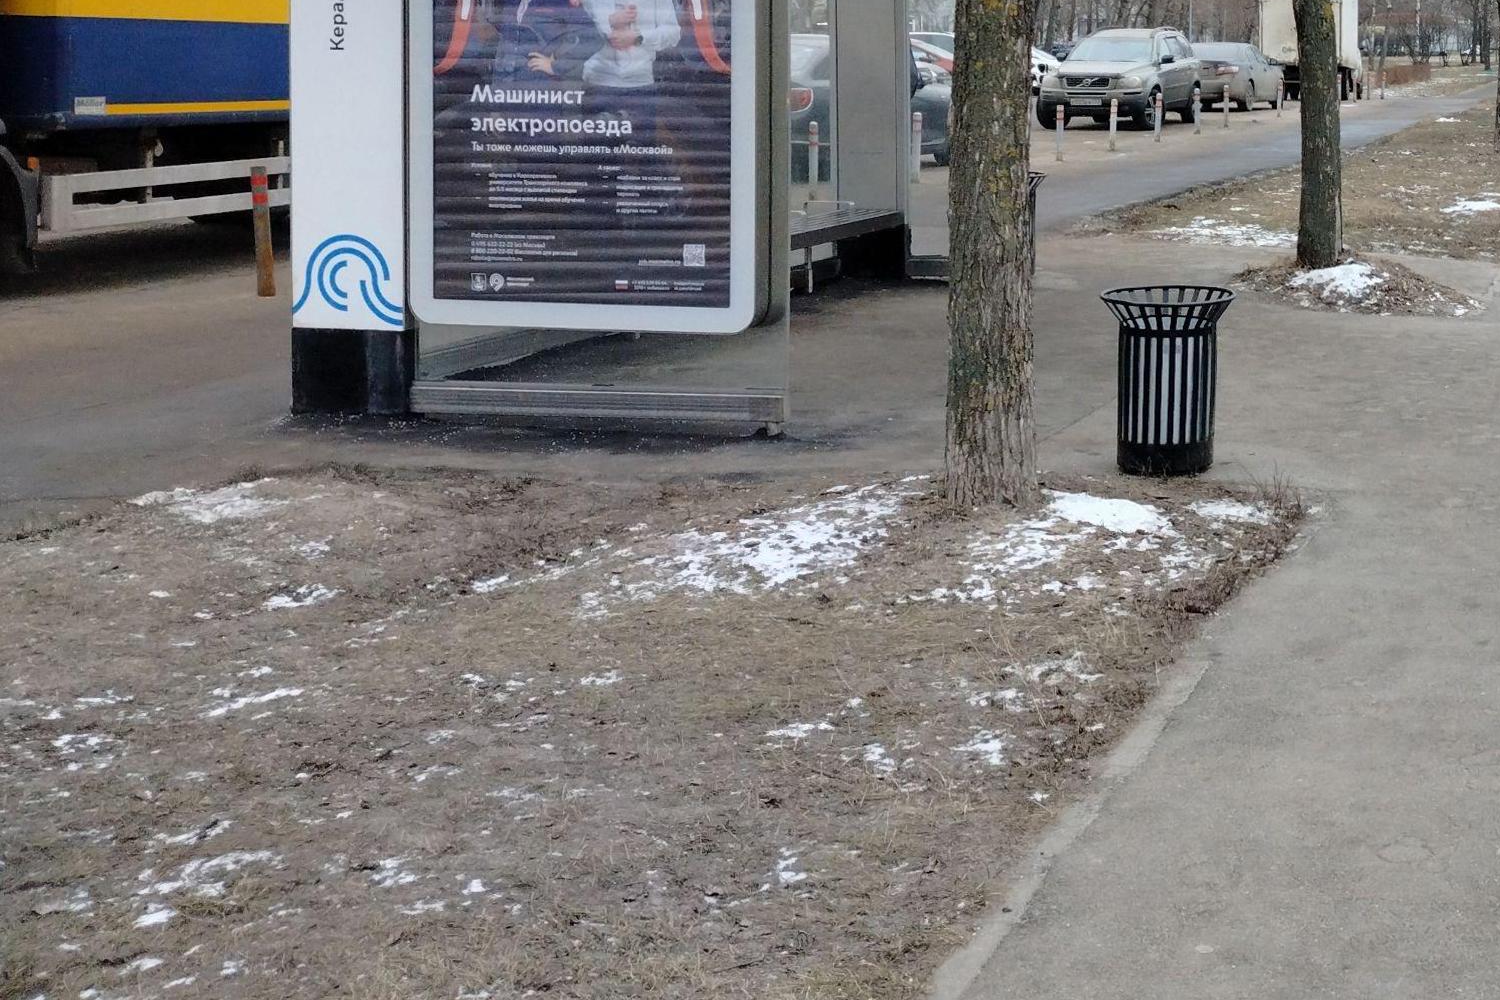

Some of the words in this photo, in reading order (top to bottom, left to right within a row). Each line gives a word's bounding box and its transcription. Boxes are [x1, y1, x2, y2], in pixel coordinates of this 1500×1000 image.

[470, 83, 585, 105] Машинист
[470, 116, 633, 137] электропоезда
[471, 141, 485, 152] Ты
[486, 143, 513, 153] тоже
[514, 144, 559, 154] можешь
[559, 144, 611, 156] управлять
